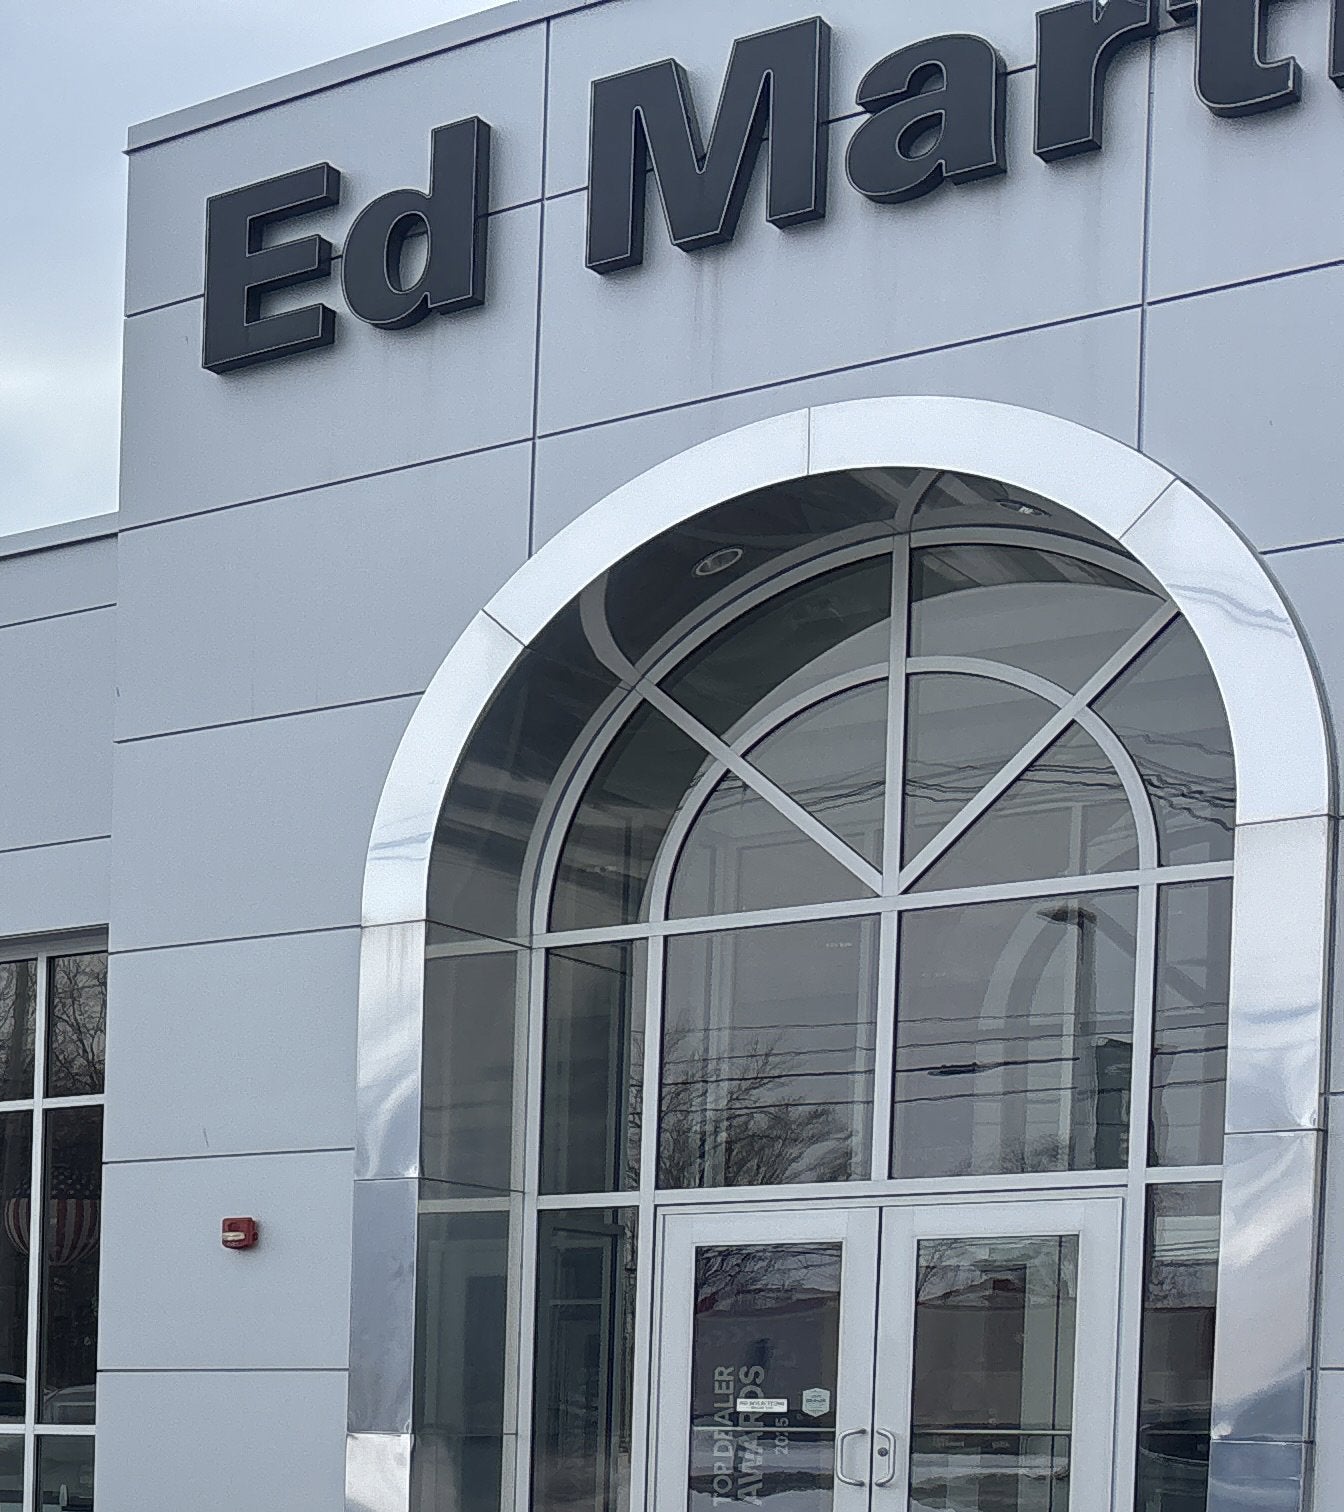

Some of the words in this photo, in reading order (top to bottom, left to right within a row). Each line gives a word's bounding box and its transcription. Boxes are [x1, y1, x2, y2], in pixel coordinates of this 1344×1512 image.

[202, 116, 491, 373] Ed
[585, 0, 1344, 274] Mart
[712, 1462, 733, 1507] TOP
